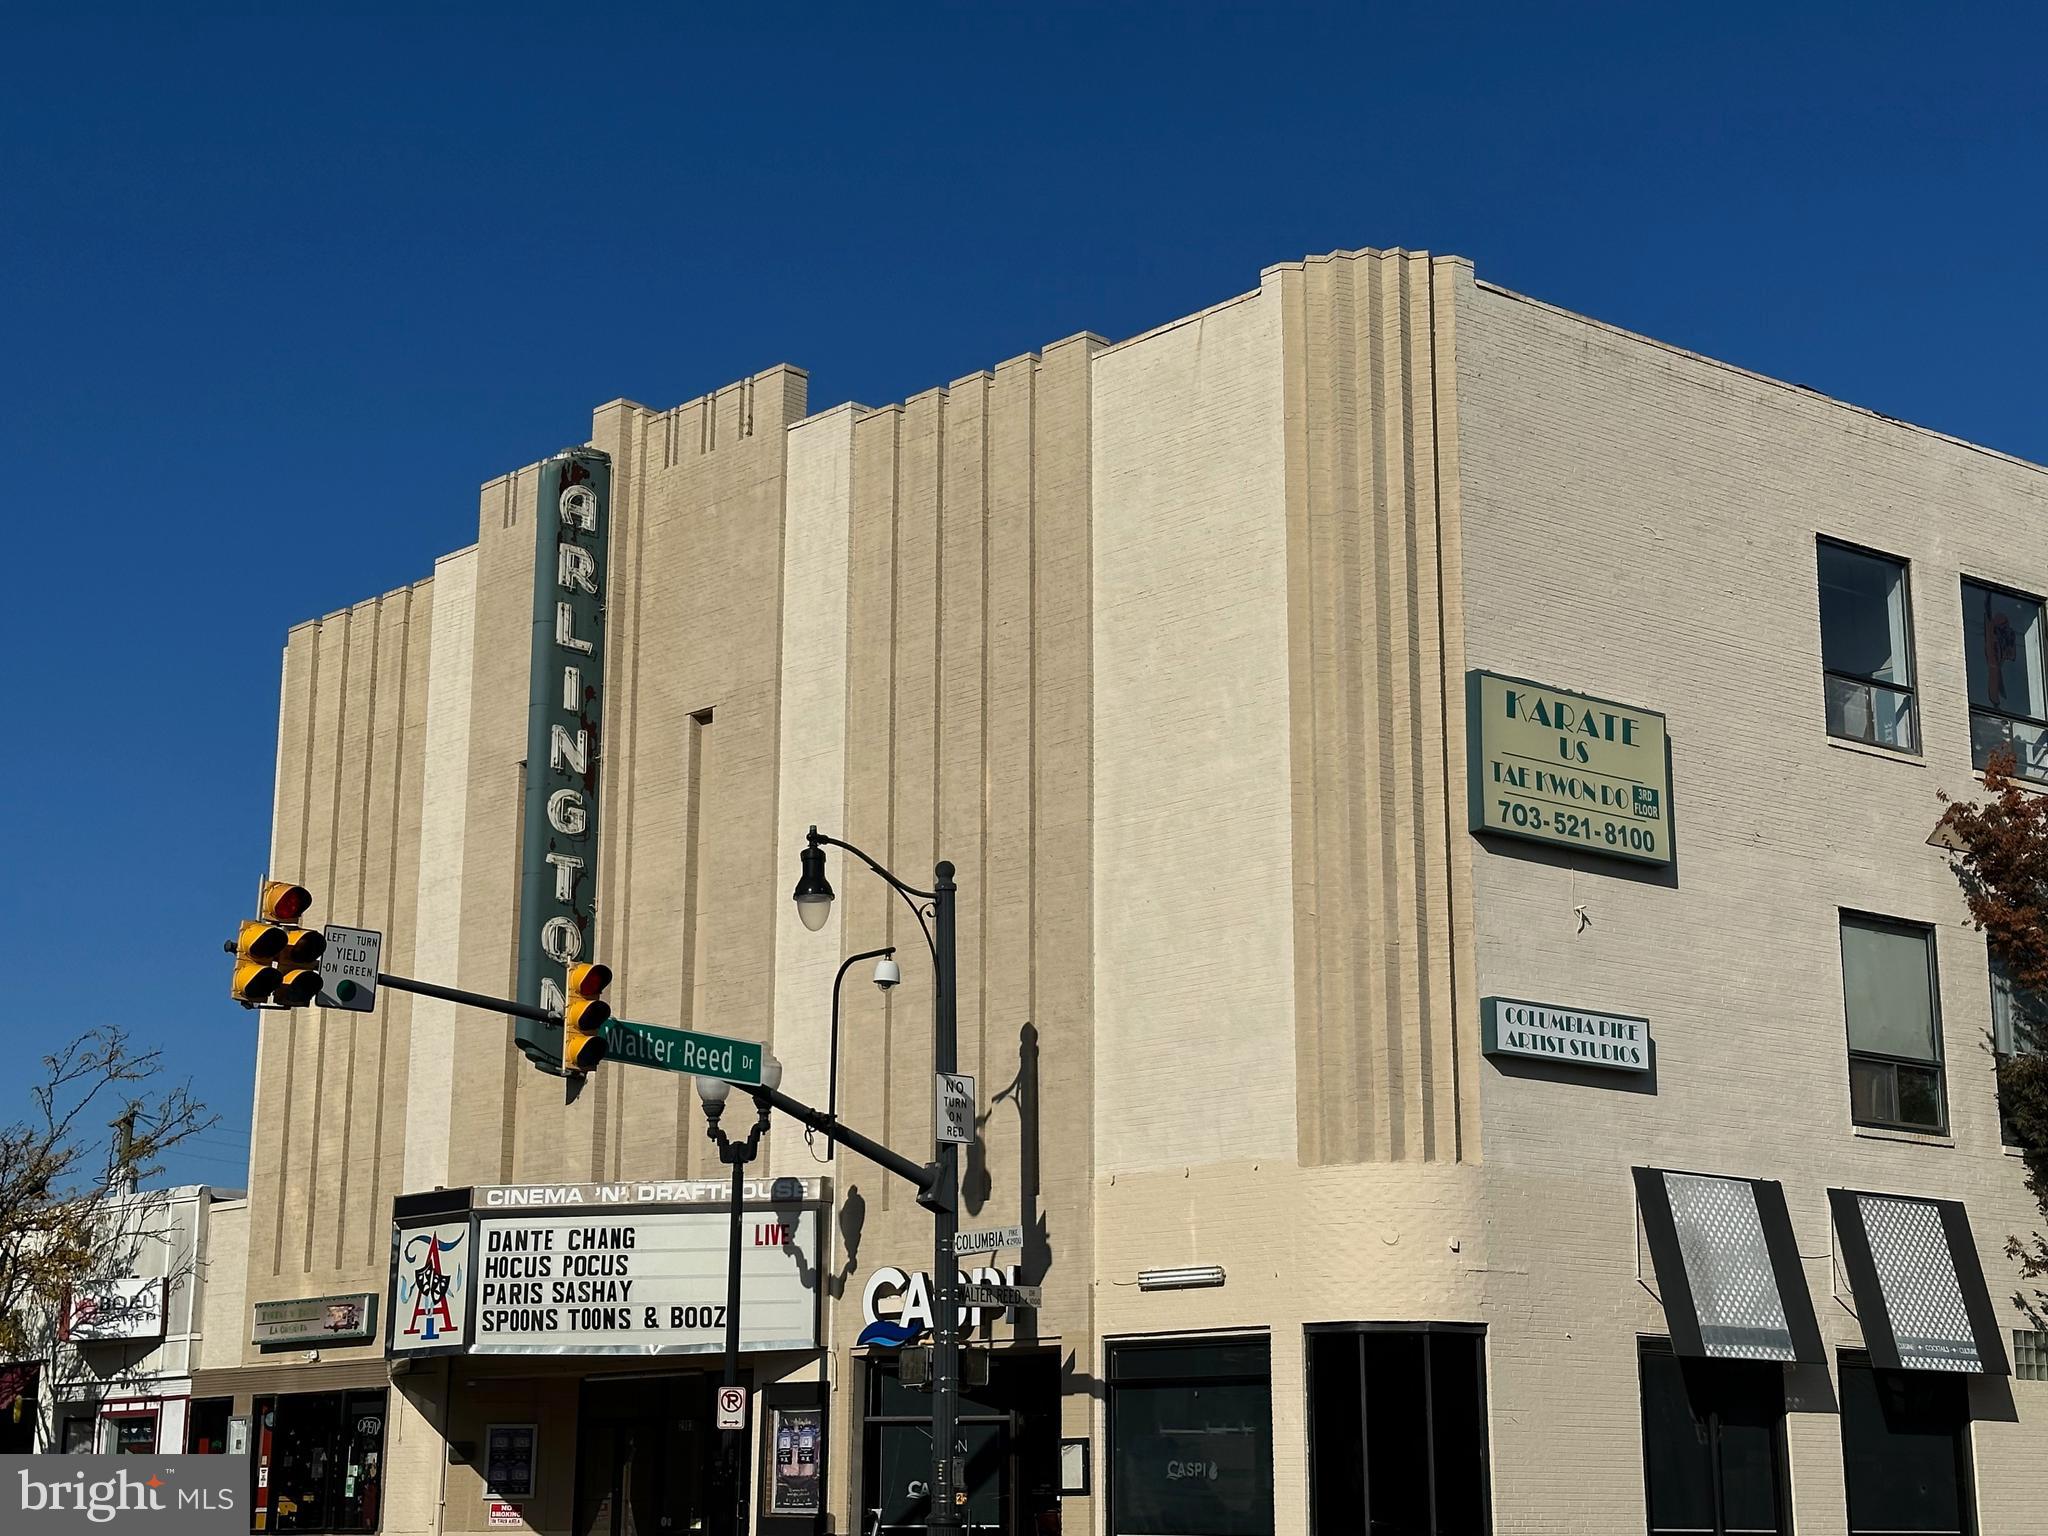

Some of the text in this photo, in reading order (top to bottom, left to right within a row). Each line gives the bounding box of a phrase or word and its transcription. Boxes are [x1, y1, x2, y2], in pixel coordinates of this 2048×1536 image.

[1506, 690, 1640, 747] KARATE
[1559, 737, 1589, 764] US
[1490, 760, 1629, 810] TAE KWON DO
[1638, 788, 1653, 801] 3RD
[1634, 803, 1658, 818] FLOOR
[1498, 800, 1655, 852] 703-521-8100
[327, 932, 378, 948] LEFT TURN
[336, 947, 366, 962] YIELD
[325, 962, 373, 977] ON GREEN
[1505, 1007, 1639, 1042] COLUMBIA PIKE
[605, 1026, 754, 1073] Walter Reed Dr
[1505, 1030, 1640, 1064] ARTIST STUDIOS
[946, 1079, 964, 1094] NO
[944, 1096, 967, 1109] TURN
[949, 1111, 962, 1123] ON
[946, 1125, 964, 1138] RED
[486, 1187, 584, 1206] CINEMA
[638, 1181, 809, 1201] DRAFTHOUSE
[488, 1227, 635, 1252] DANTE CHANG
[754, 1224, 790, 1246] LIVE
[956, 1231, 1005, 1251] COLUMBIA
[485, 1254, 629, 1279] HOCUS POCUS
[482, 1280, 633, 1305] PARIS SASHAY
[862, 1265, 1018, 1331] CAPI
[996, 1288, 1021, 1304] REED
[482, 1308, 558, 1332] SPOONS
[568, 1307, 631, 1331] TOONS
[644, 1306, 660, 1329] &
[358, 1418, 381, 1435] OPEN
[1167, 1460, 1207, 1479] CASPI
